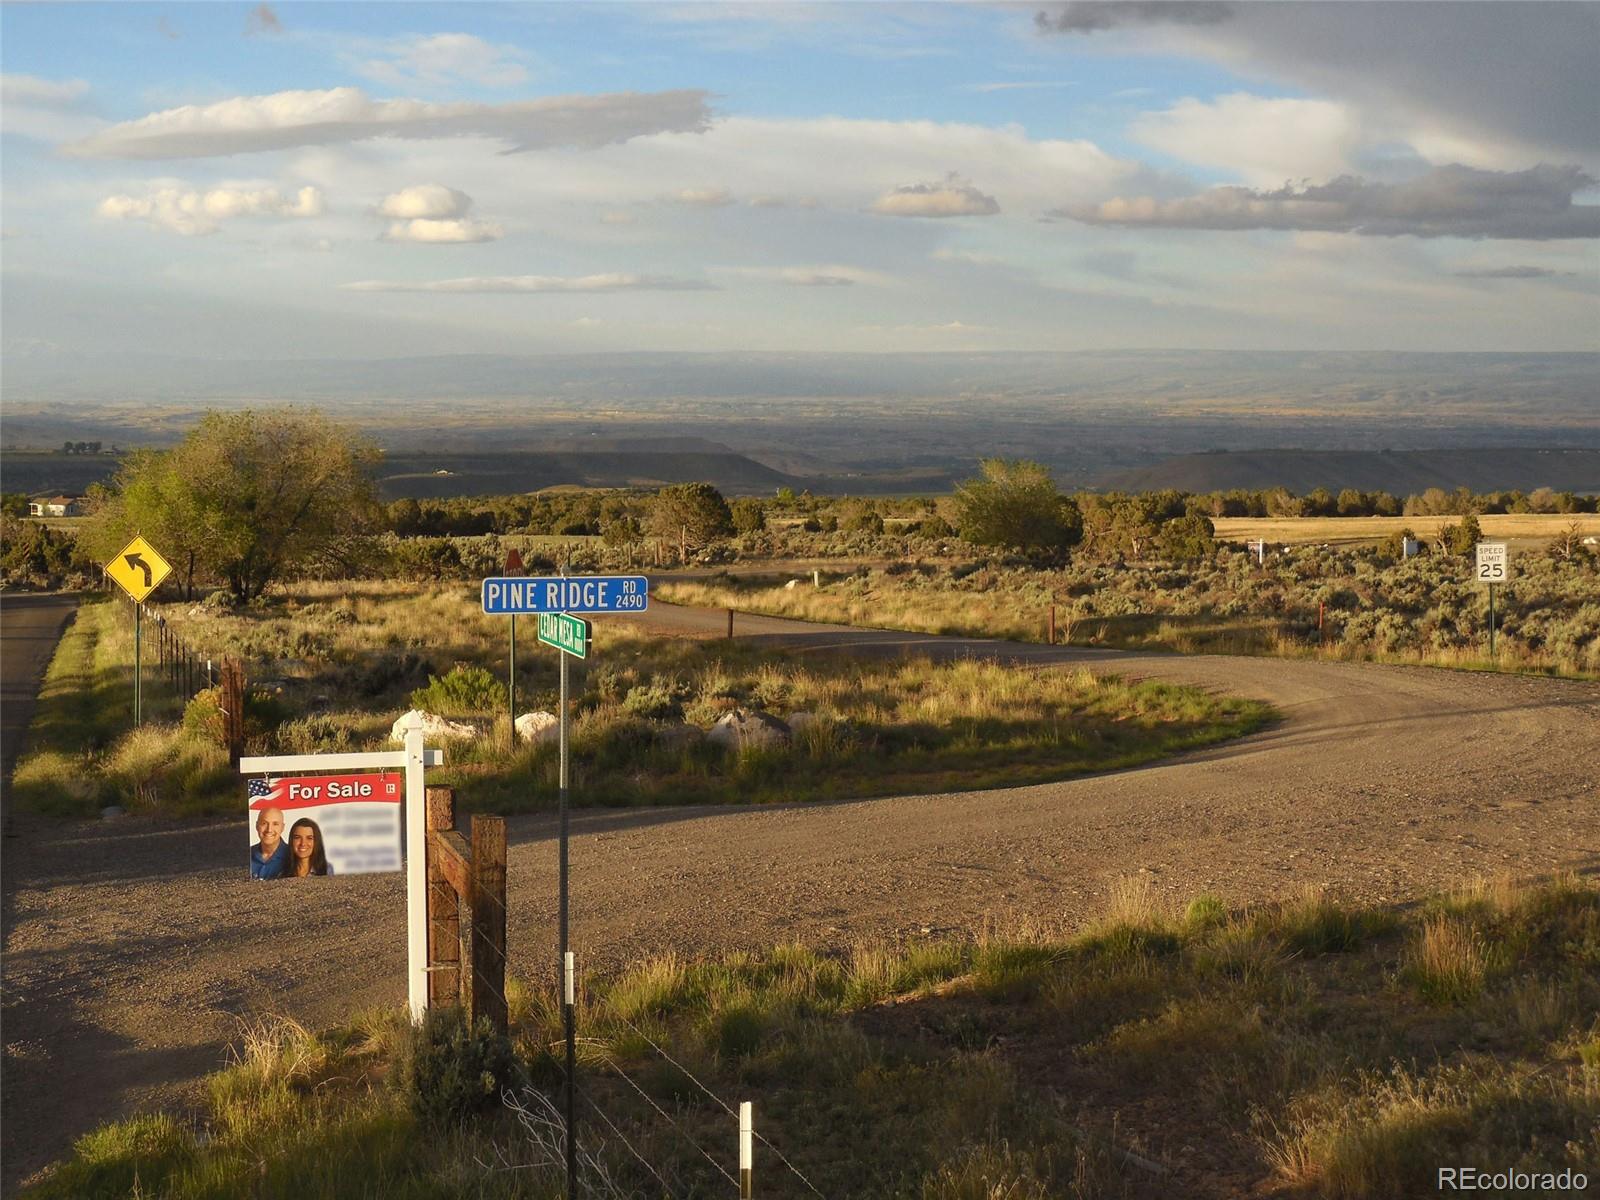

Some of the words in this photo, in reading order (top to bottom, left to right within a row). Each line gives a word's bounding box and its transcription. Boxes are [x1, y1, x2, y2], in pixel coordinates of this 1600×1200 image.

[1479, 547, 1504, 555] SPEED
[1480, 563, 1503, 578] 25
[623, 580, 636, 594] RD
[488, 583, 537, 609] PINE
[546, 582, 608, 608] RIDGE
[616, 594, 643, 608] 2490
[559, 617, 574, 649] MESA
[289, 783, 322, 800] For
[327, 781, 373, 798] Sale
